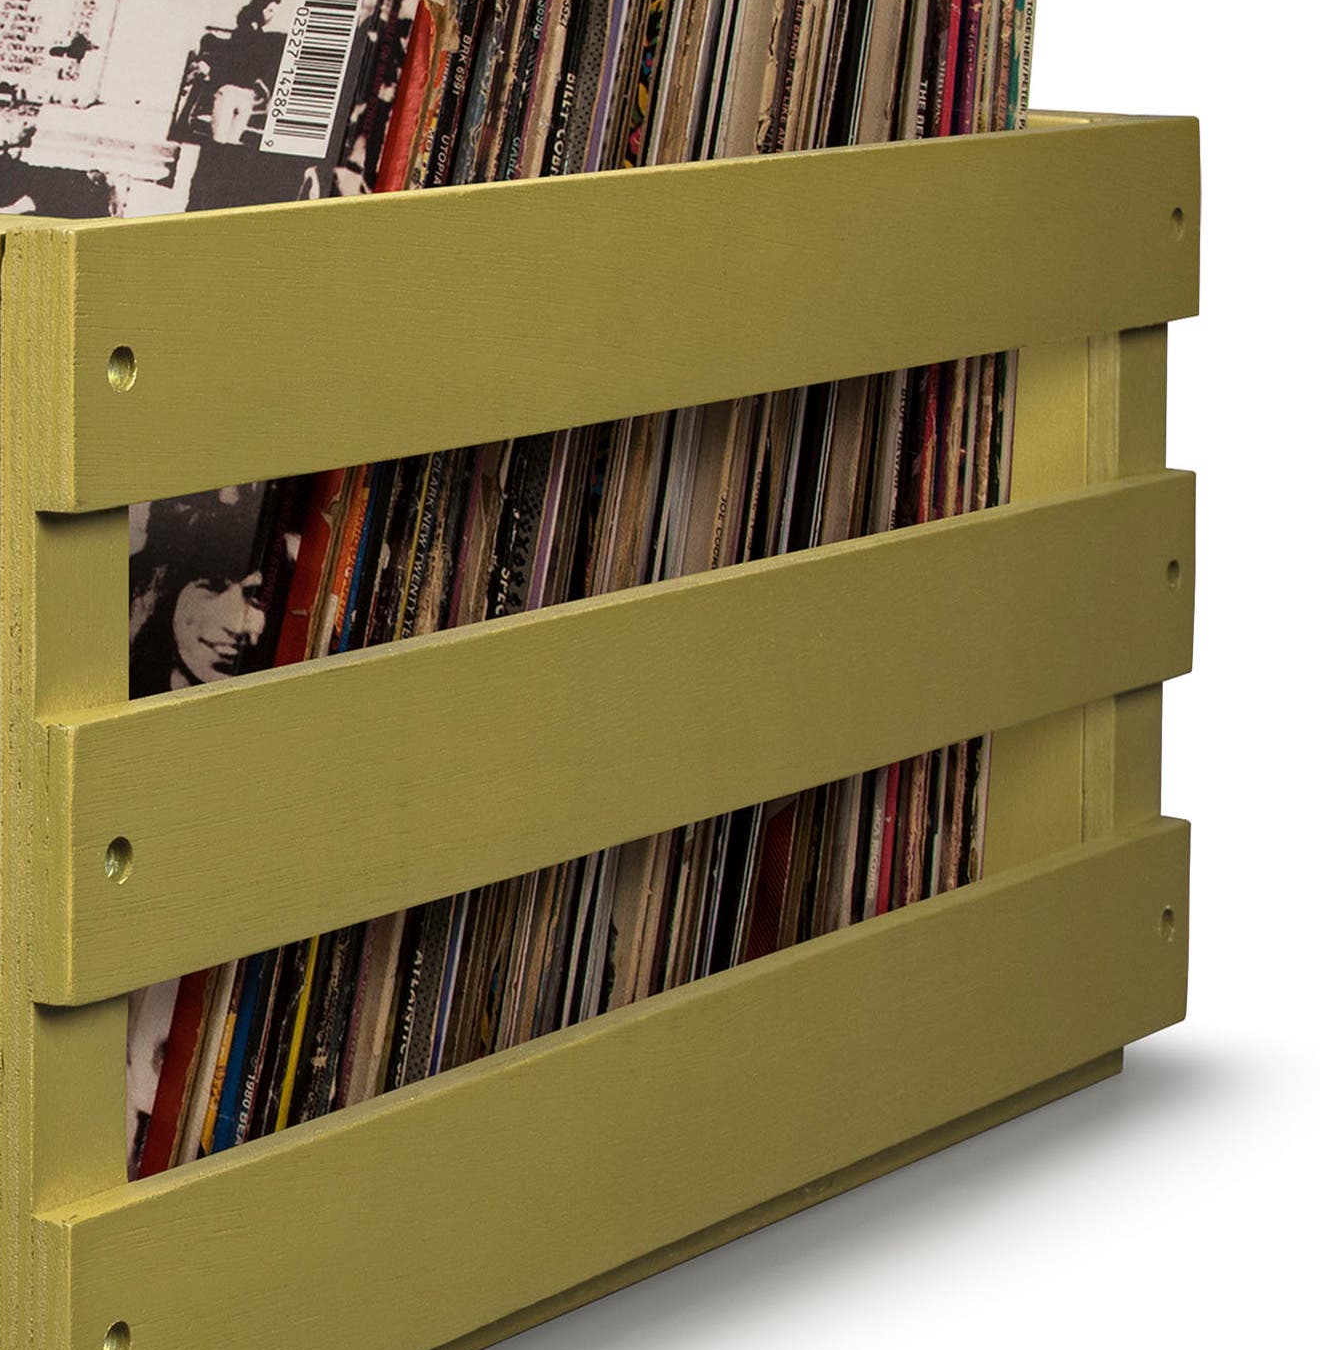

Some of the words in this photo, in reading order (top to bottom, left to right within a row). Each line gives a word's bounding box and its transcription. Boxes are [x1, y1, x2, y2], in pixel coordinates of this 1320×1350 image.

[287, 6, 310, 58] 02527
[458, 34, 471, 62] BRK
[788, 23, 801, 59] BAND
[271, 67, 295, 118] 14286
[451, 66, 465, 95] 6991
[783, 68, 795, 93] FLY
[917, 79, 928, 109] THE
[779, 95, 791, 123] LIKE
[914, 114, 925, 139] BE
[432, 134, 450, 185] UTOPIA
[425, 457, 442, 507] CLARK
[717, 495, 727, 519] JOE
[417, 511, 433, 547] NEW
[407, 551, 426, 617] TWENTY
[400, 619, 413, 637] YE
[240, 1073, 256, 1109] 1980
